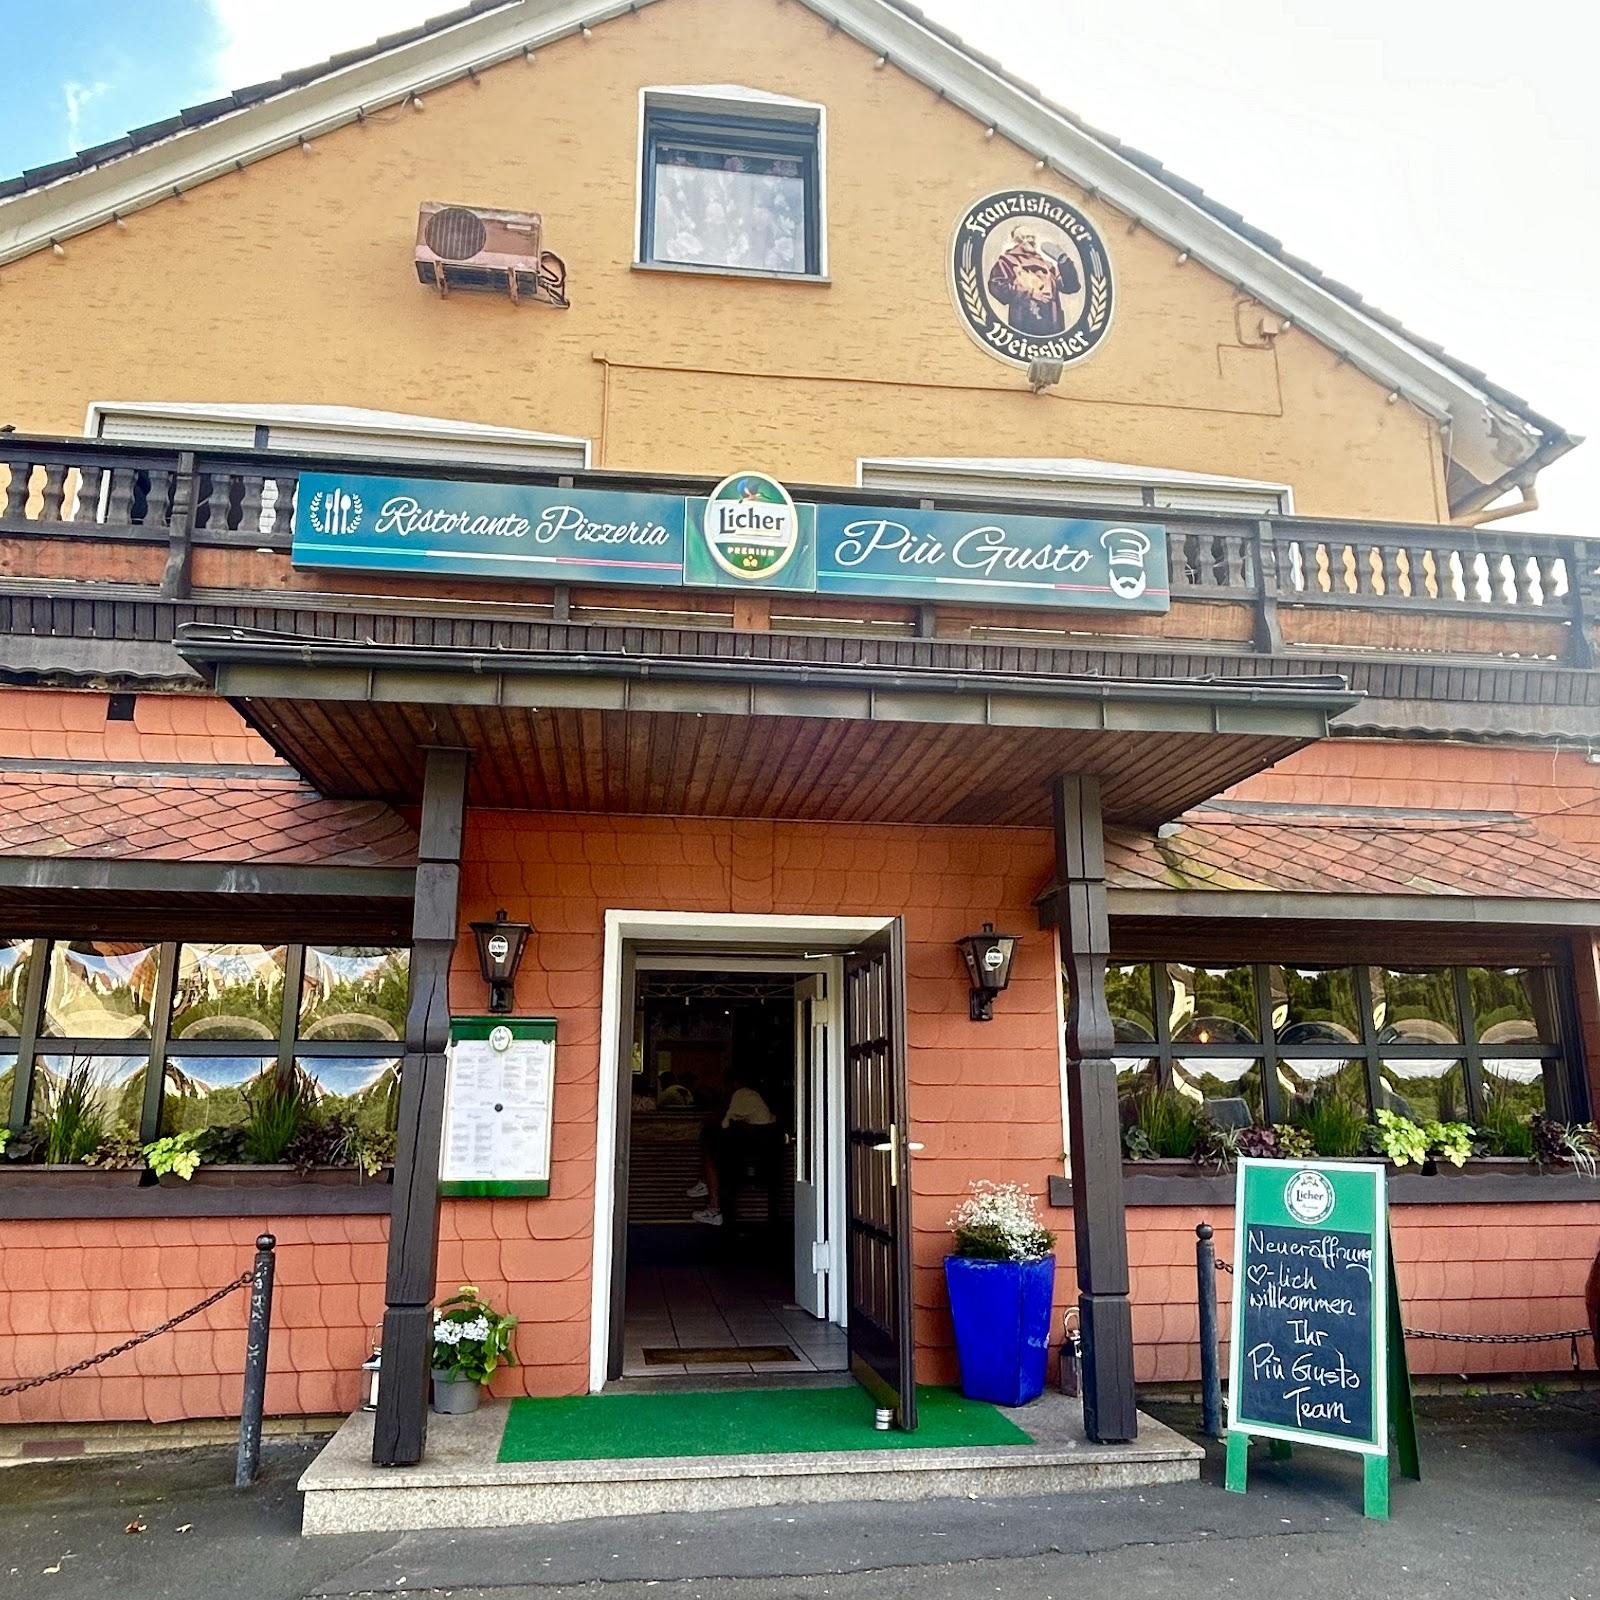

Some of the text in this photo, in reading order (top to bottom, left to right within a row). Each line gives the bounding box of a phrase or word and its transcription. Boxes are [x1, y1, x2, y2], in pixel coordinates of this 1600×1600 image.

[965, 194, 1093, 241] Franziskaner
[986, 322, 1089, 359] Weissbier
[375, 496, 670, 546] Ristorante Pizzeria
[719, 507, 785, 534] Licher
[727, 546, 775, 557] PREMIUM
[835, 520, 1094, 576] Più Gusto
[1296, 1189, 1324, 1202] Licher
[1249, 1281, 1356, 1315] willkommen
[1286, 1319, 1329, 1346] Ihr
[1291, 1348, 1360, 1388] Gusto
[1283, 1386, 1351, 1427] Team
